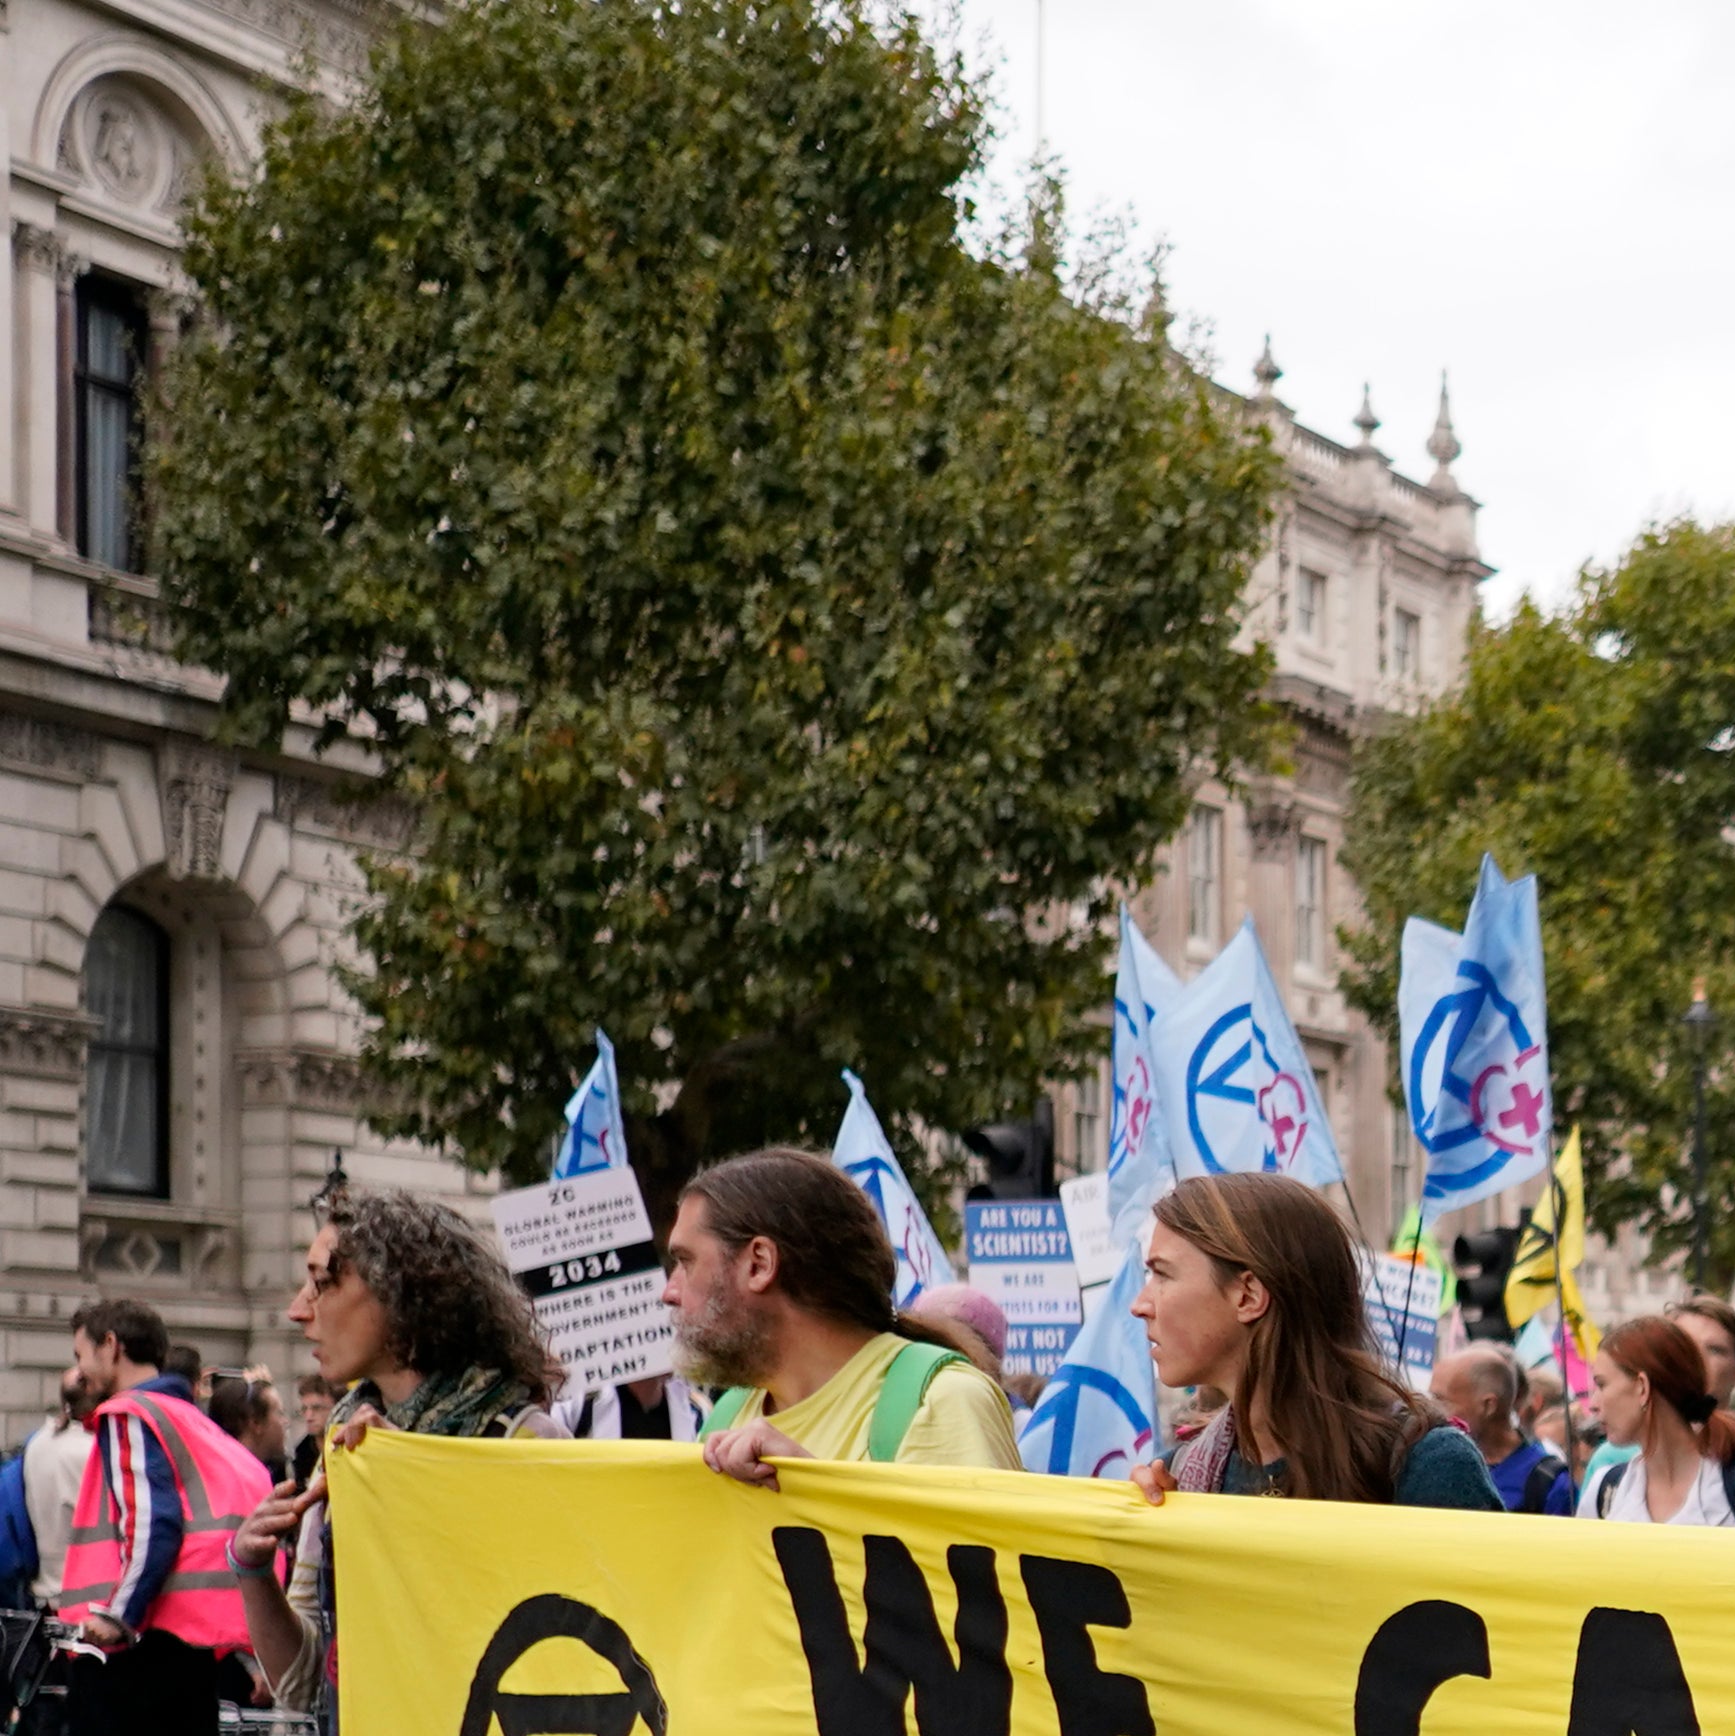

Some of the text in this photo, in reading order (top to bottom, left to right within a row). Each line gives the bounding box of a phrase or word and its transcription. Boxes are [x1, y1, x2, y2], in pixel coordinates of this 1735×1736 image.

[504, 1197, 634, 1236] GLOBAL WARMING
[980, 1208, 1057, 1228] ARE YOU A
[973, 1231, 1068, 1257] SCIENTIST?
[550, 1250, 621, 1288] 2034
[1003, 1275, 1044, 1286] WE ARE
[536, 1280, 653, 1317] WHERE IS THE
[1038, 1302, 1058, 1314] FOR
[541, 1300, 664, 1337] OVERNMENT'S
[560, 1325, 673, 1364] DAPTATION
[1007, 1329, 1065, 1350] HY NOT
[585, 1356, 647, 1383] PLAN?
[1003, 1355, 1031, 1376] OIN
